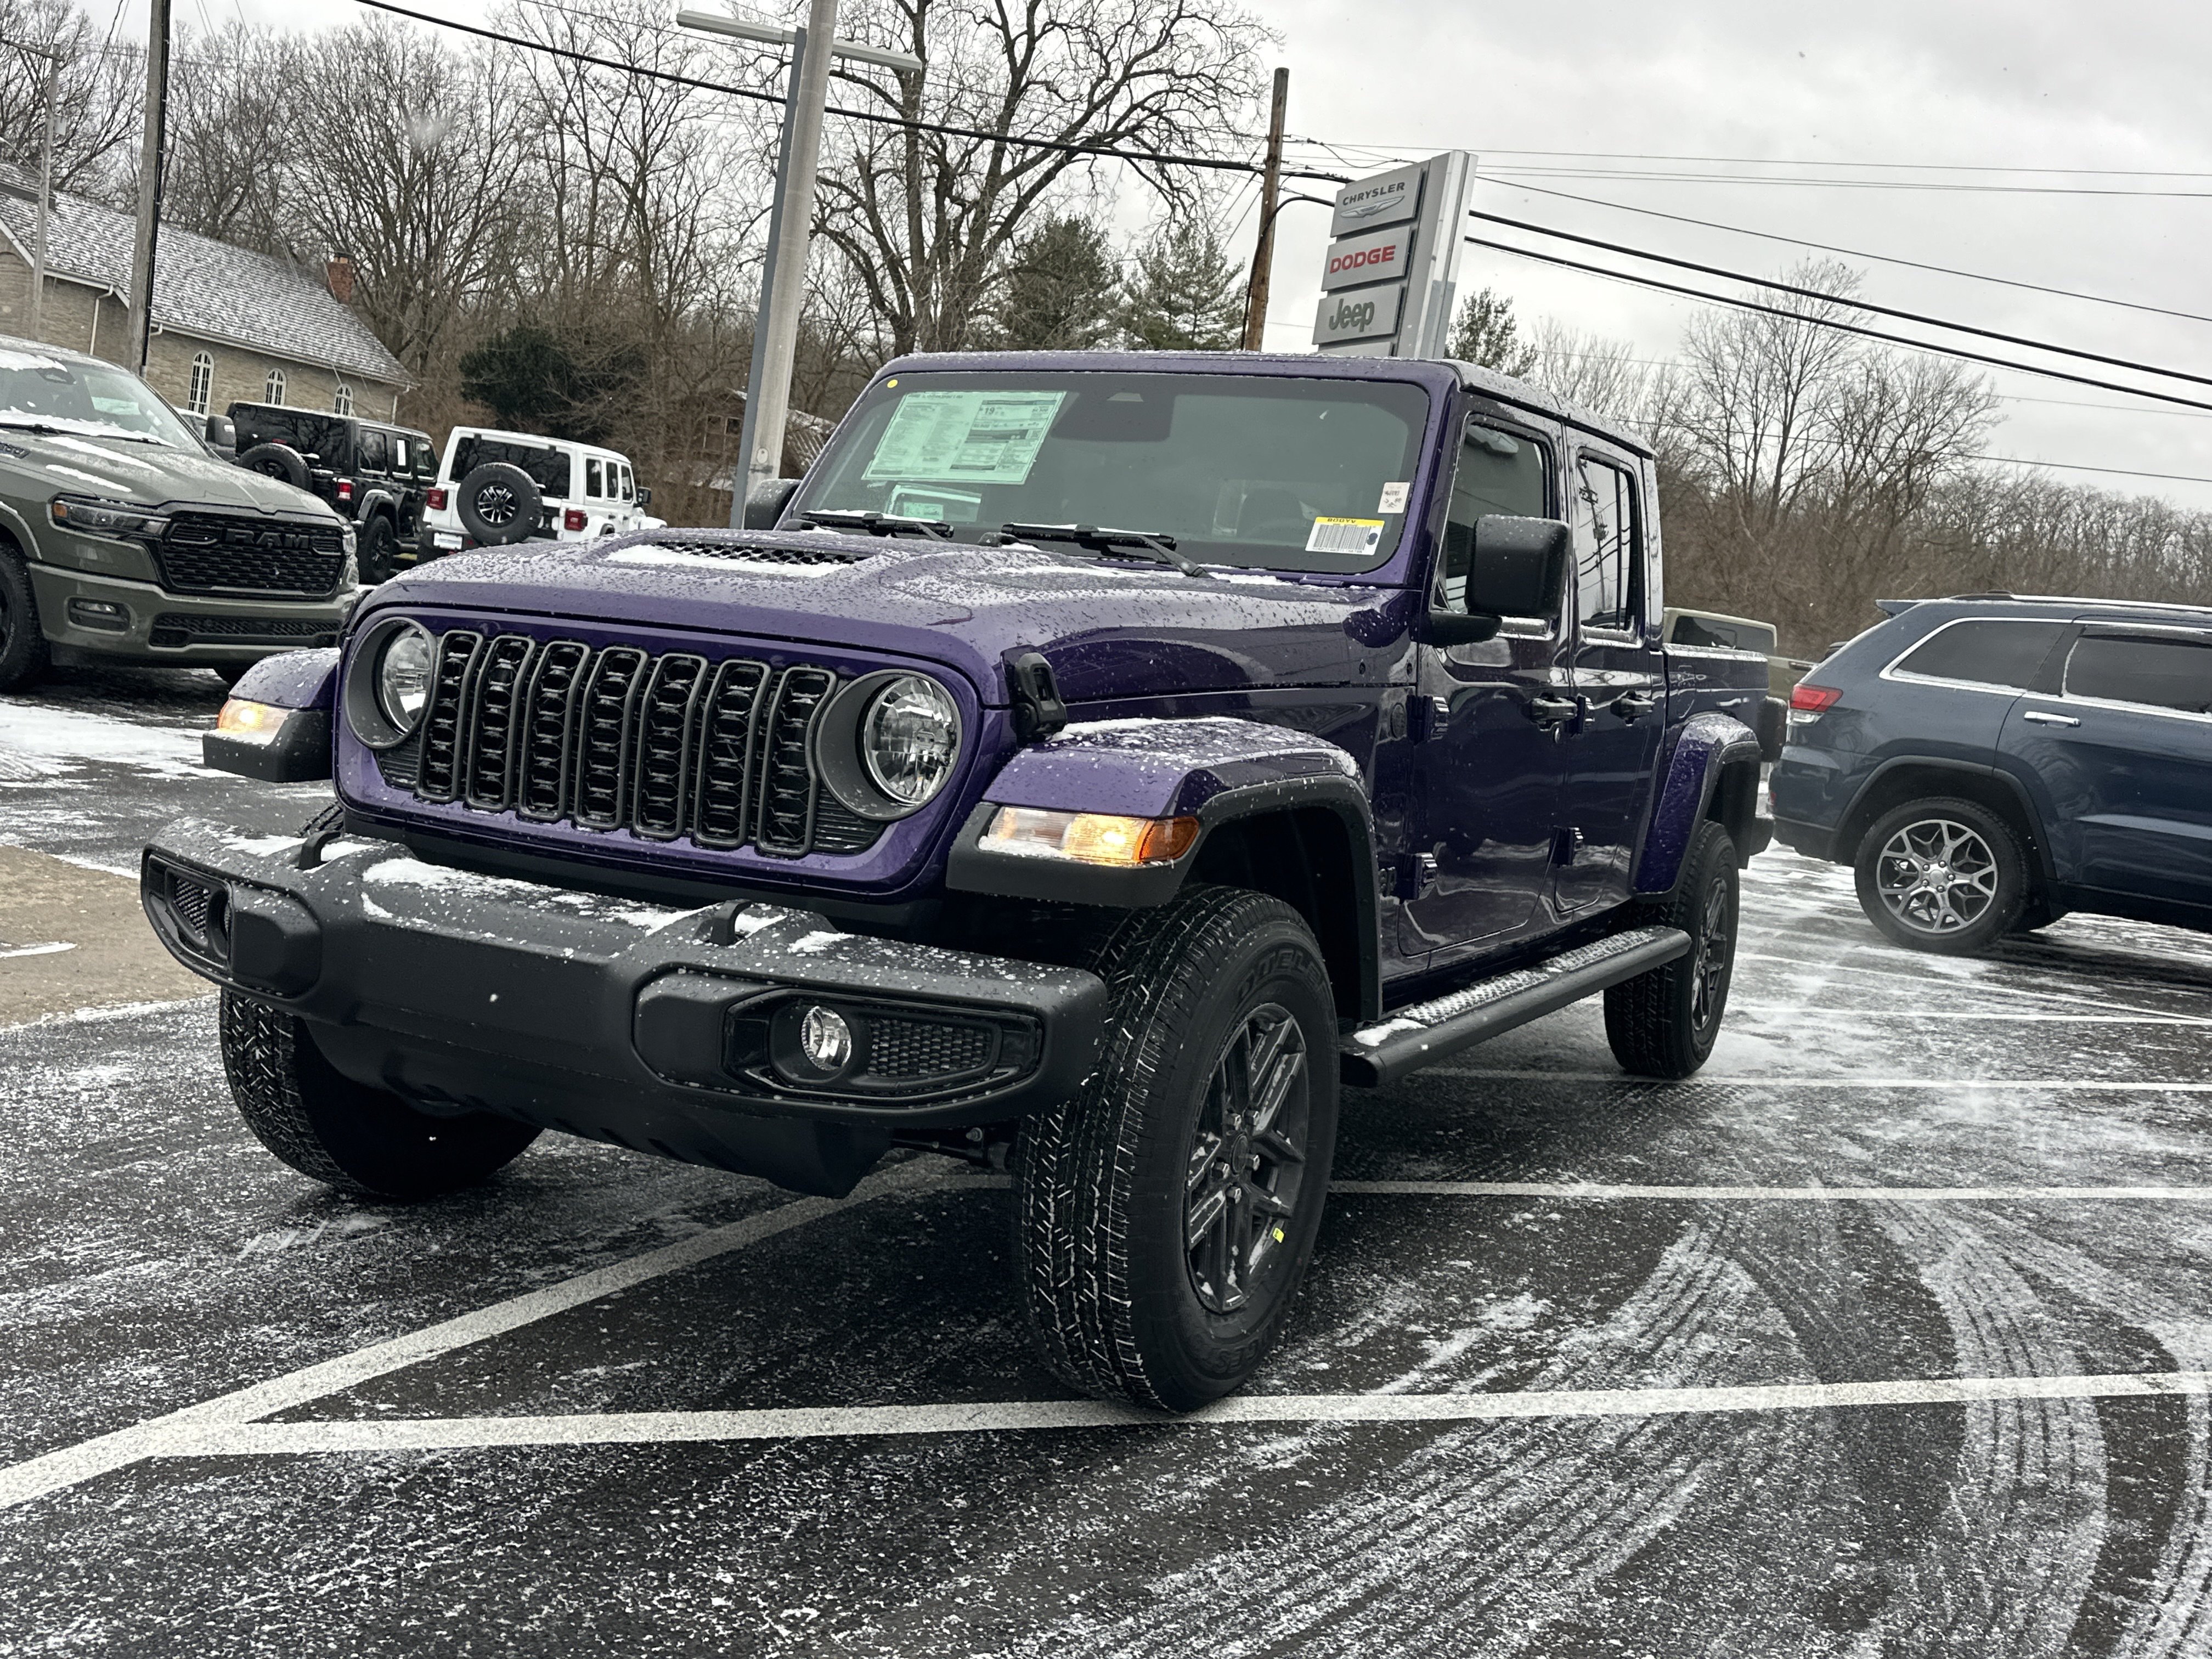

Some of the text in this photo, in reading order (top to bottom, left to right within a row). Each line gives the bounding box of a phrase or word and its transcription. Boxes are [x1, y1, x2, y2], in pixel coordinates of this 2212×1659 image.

[1343, 182, 1405, 206] CHRYSLER
[1330, 245, 1396, 274] DODGE
[1329, 298, 1375, 332] Jeep
[225, 528, 309, 549] RAM
